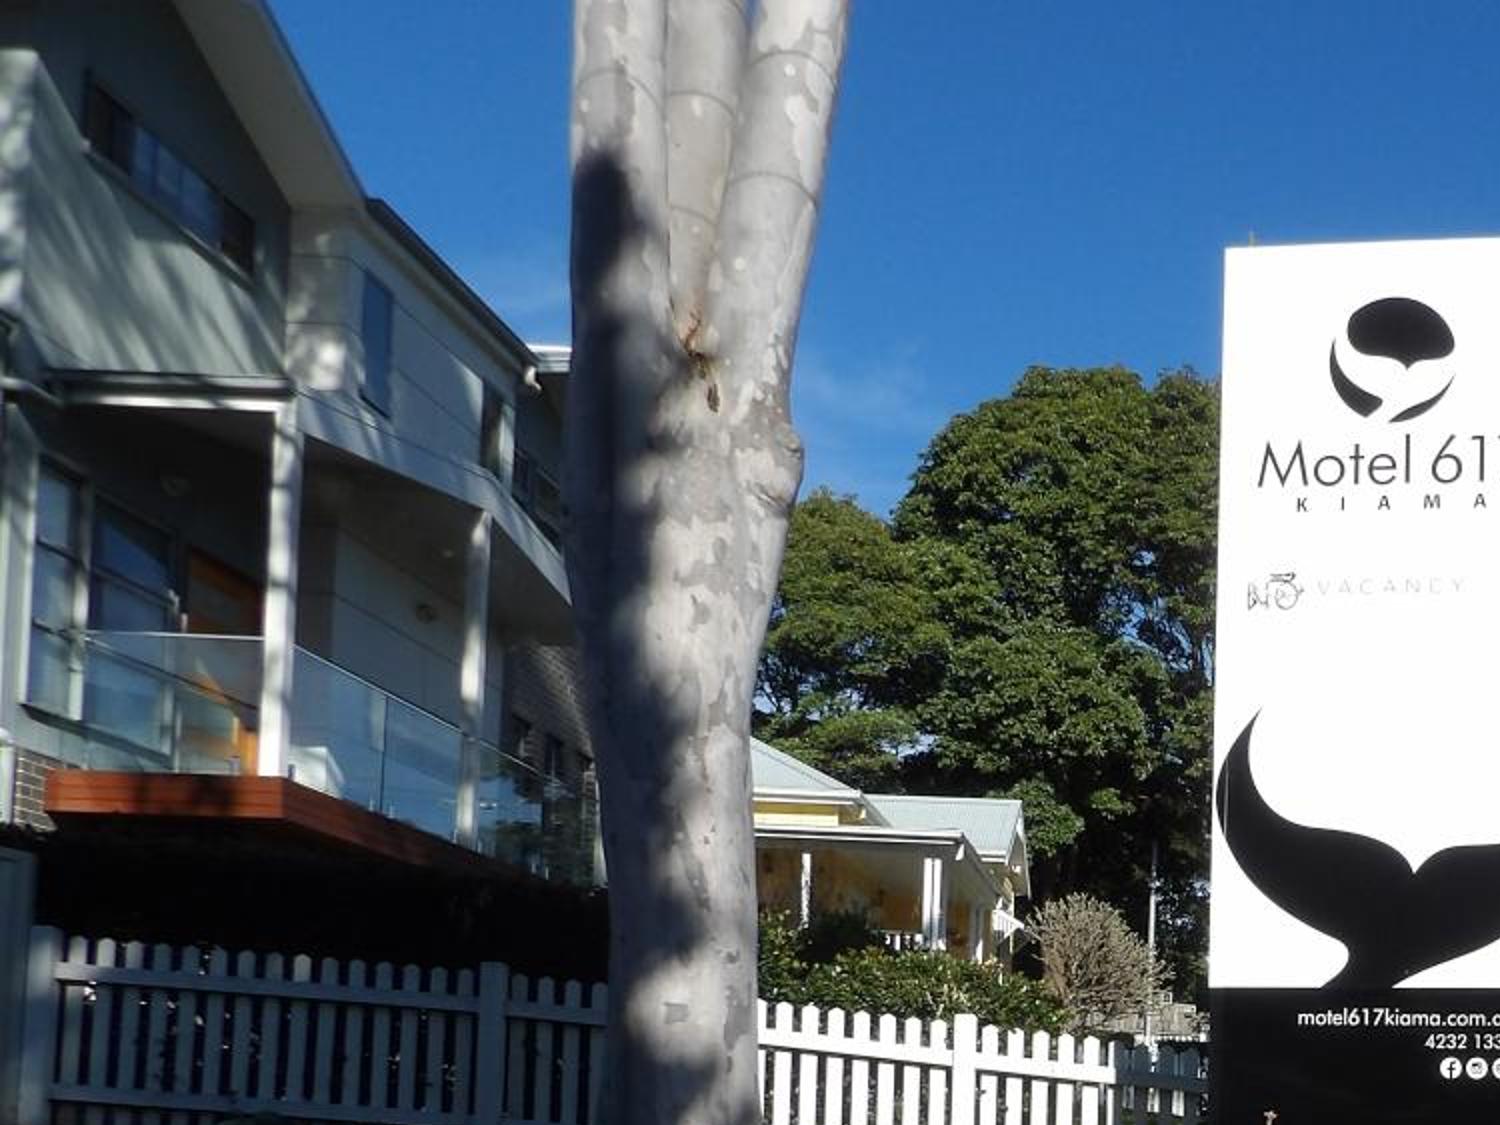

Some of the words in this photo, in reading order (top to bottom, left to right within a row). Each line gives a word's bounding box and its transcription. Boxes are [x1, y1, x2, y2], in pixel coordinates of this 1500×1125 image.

[1257, 433, 1411, 488] Motel
[1296, 493, 1488, 513] KIAMA
[1316, 576, 1466, 596] VACANCY
[1424, 1033, 1468, 1050] 4232
